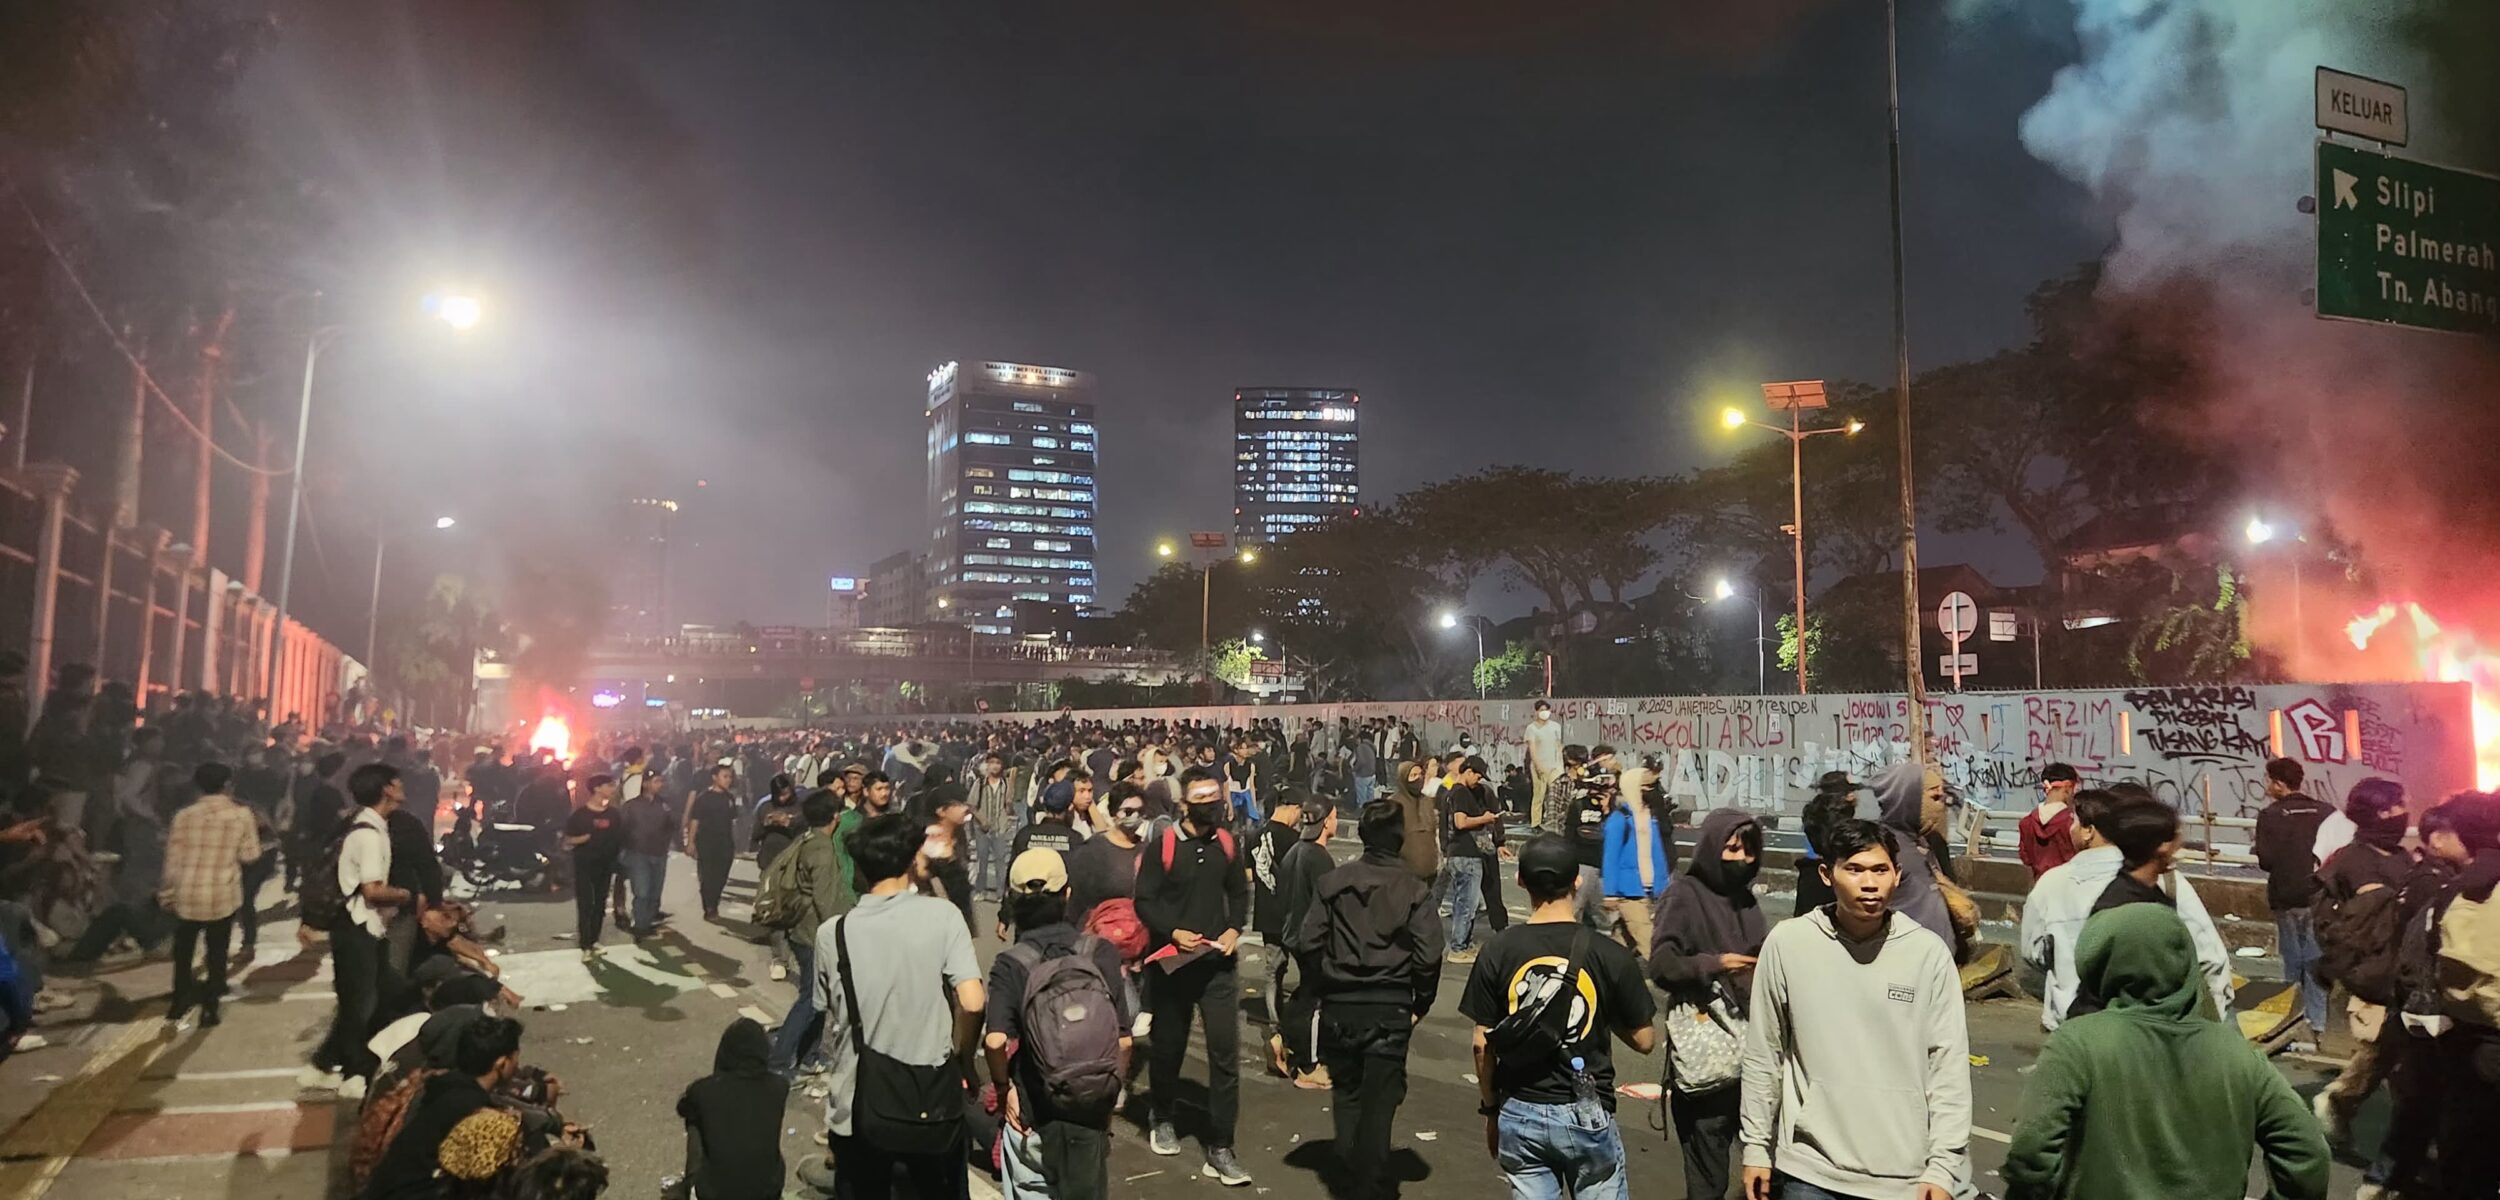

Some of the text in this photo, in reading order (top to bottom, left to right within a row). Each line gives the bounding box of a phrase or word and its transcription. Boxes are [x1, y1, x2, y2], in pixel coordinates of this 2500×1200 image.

[2331, 88, 2392, 125] KELUAR
[2377, 176, 2434, 218] Slipi
[2376, 223, 2495, 271] Palmerah
[2377, 272, 2497, 324] Tn. Abang
[1334, 409, 1354, 421] BNI
[2024, 697, 2113, 730] REZIM
[2124, 687, 2257, 711] DEMOKRASI
[2137, 728, 2218, 752] TUKANG
